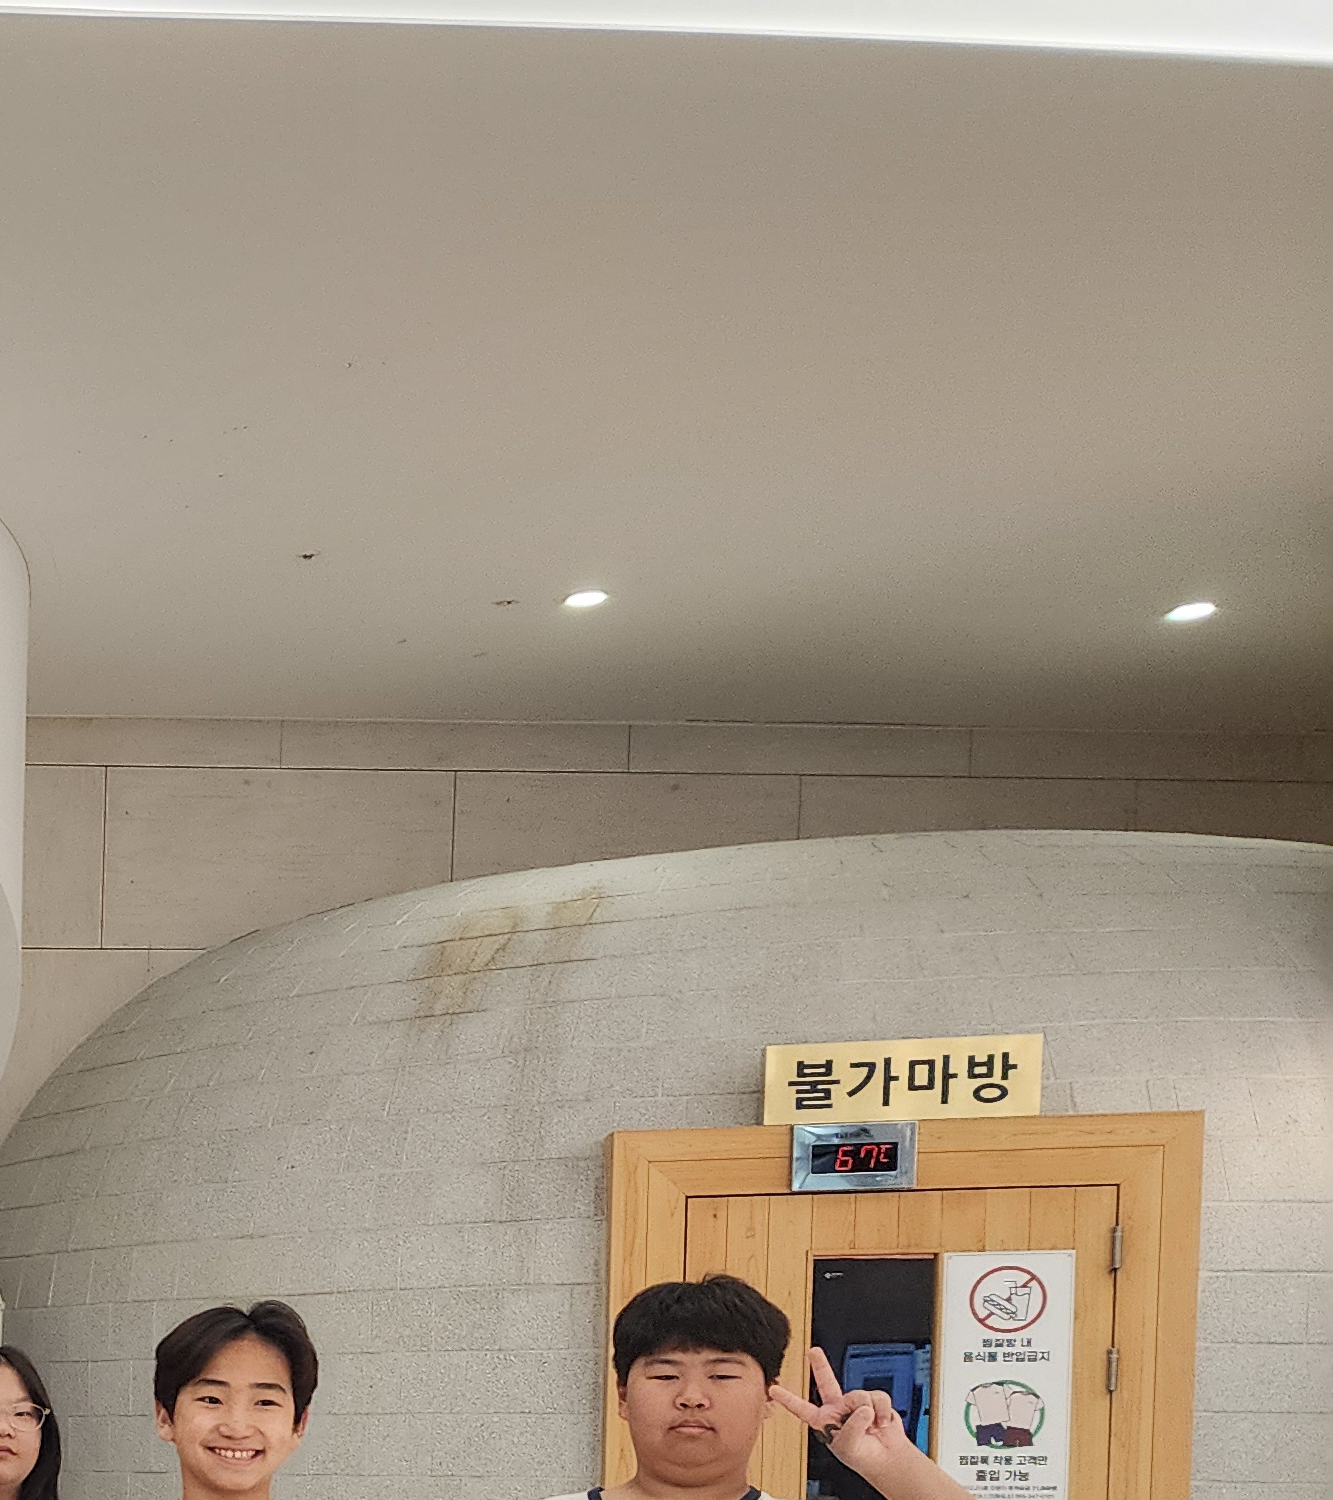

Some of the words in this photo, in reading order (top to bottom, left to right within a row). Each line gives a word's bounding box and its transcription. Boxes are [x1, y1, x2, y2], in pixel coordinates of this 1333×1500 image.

[787, 1051, 1018, 1111] 불가마방
[1002, 1350, 1050, 1362] 반입금지
[1004, 1469, 1030, 1481] 가능
